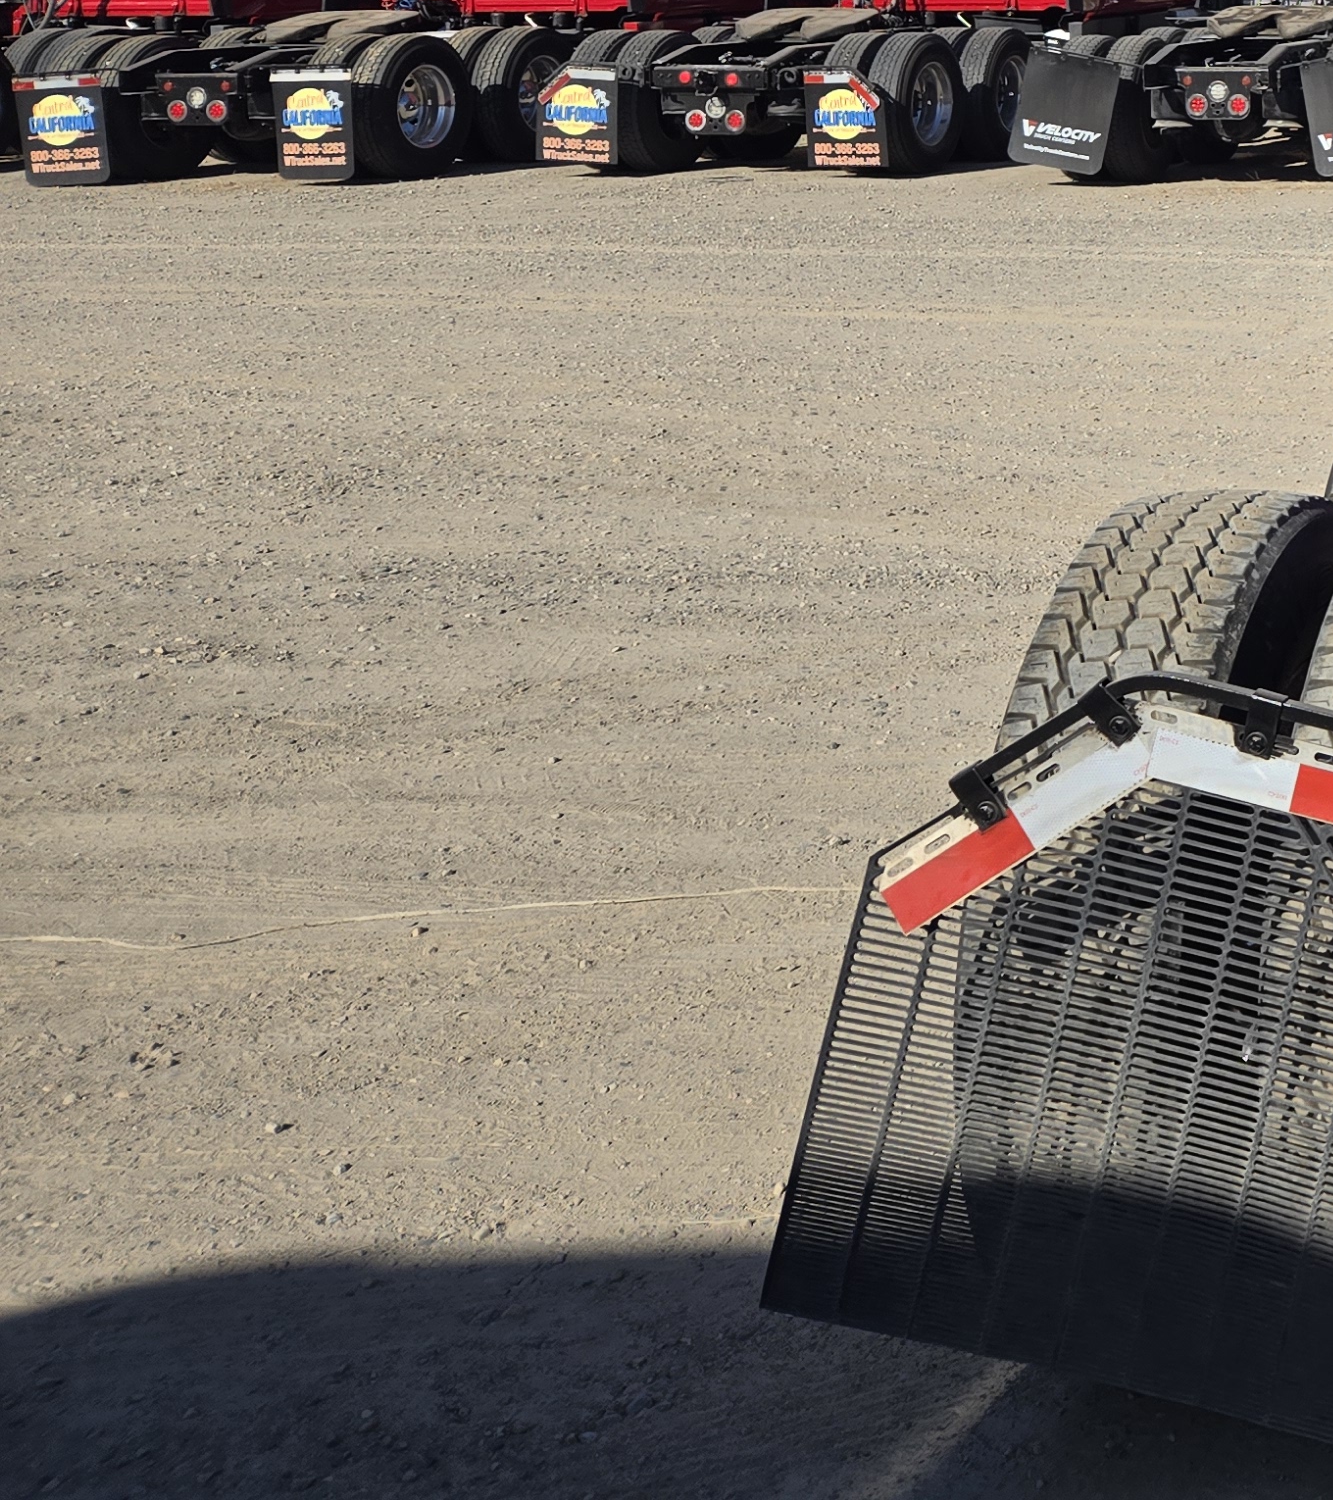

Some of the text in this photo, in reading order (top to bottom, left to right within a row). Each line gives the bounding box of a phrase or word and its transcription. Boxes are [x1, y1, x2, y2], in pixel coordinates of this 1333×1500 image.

[552, 86, 592, 104] Central
[819, 89, 858, 110] Central
[282, 108, 343, 127] CALIFORNIA
[545, 103, 608, 124] CALIFORNIA
[814, 108, 876, 127] CALIFORNIA
[28, 113, 95, 134] CALIFORNIA
[1036, 122, 1102, 143] VELOCITY
[283, 141, 346, 155] 800-366-3263
[543, 136, 610, 152] 800-366-3263
[814, 142, 880, 155] 800-366-3263
[30, 146, 100, 162] 800-366-3263
